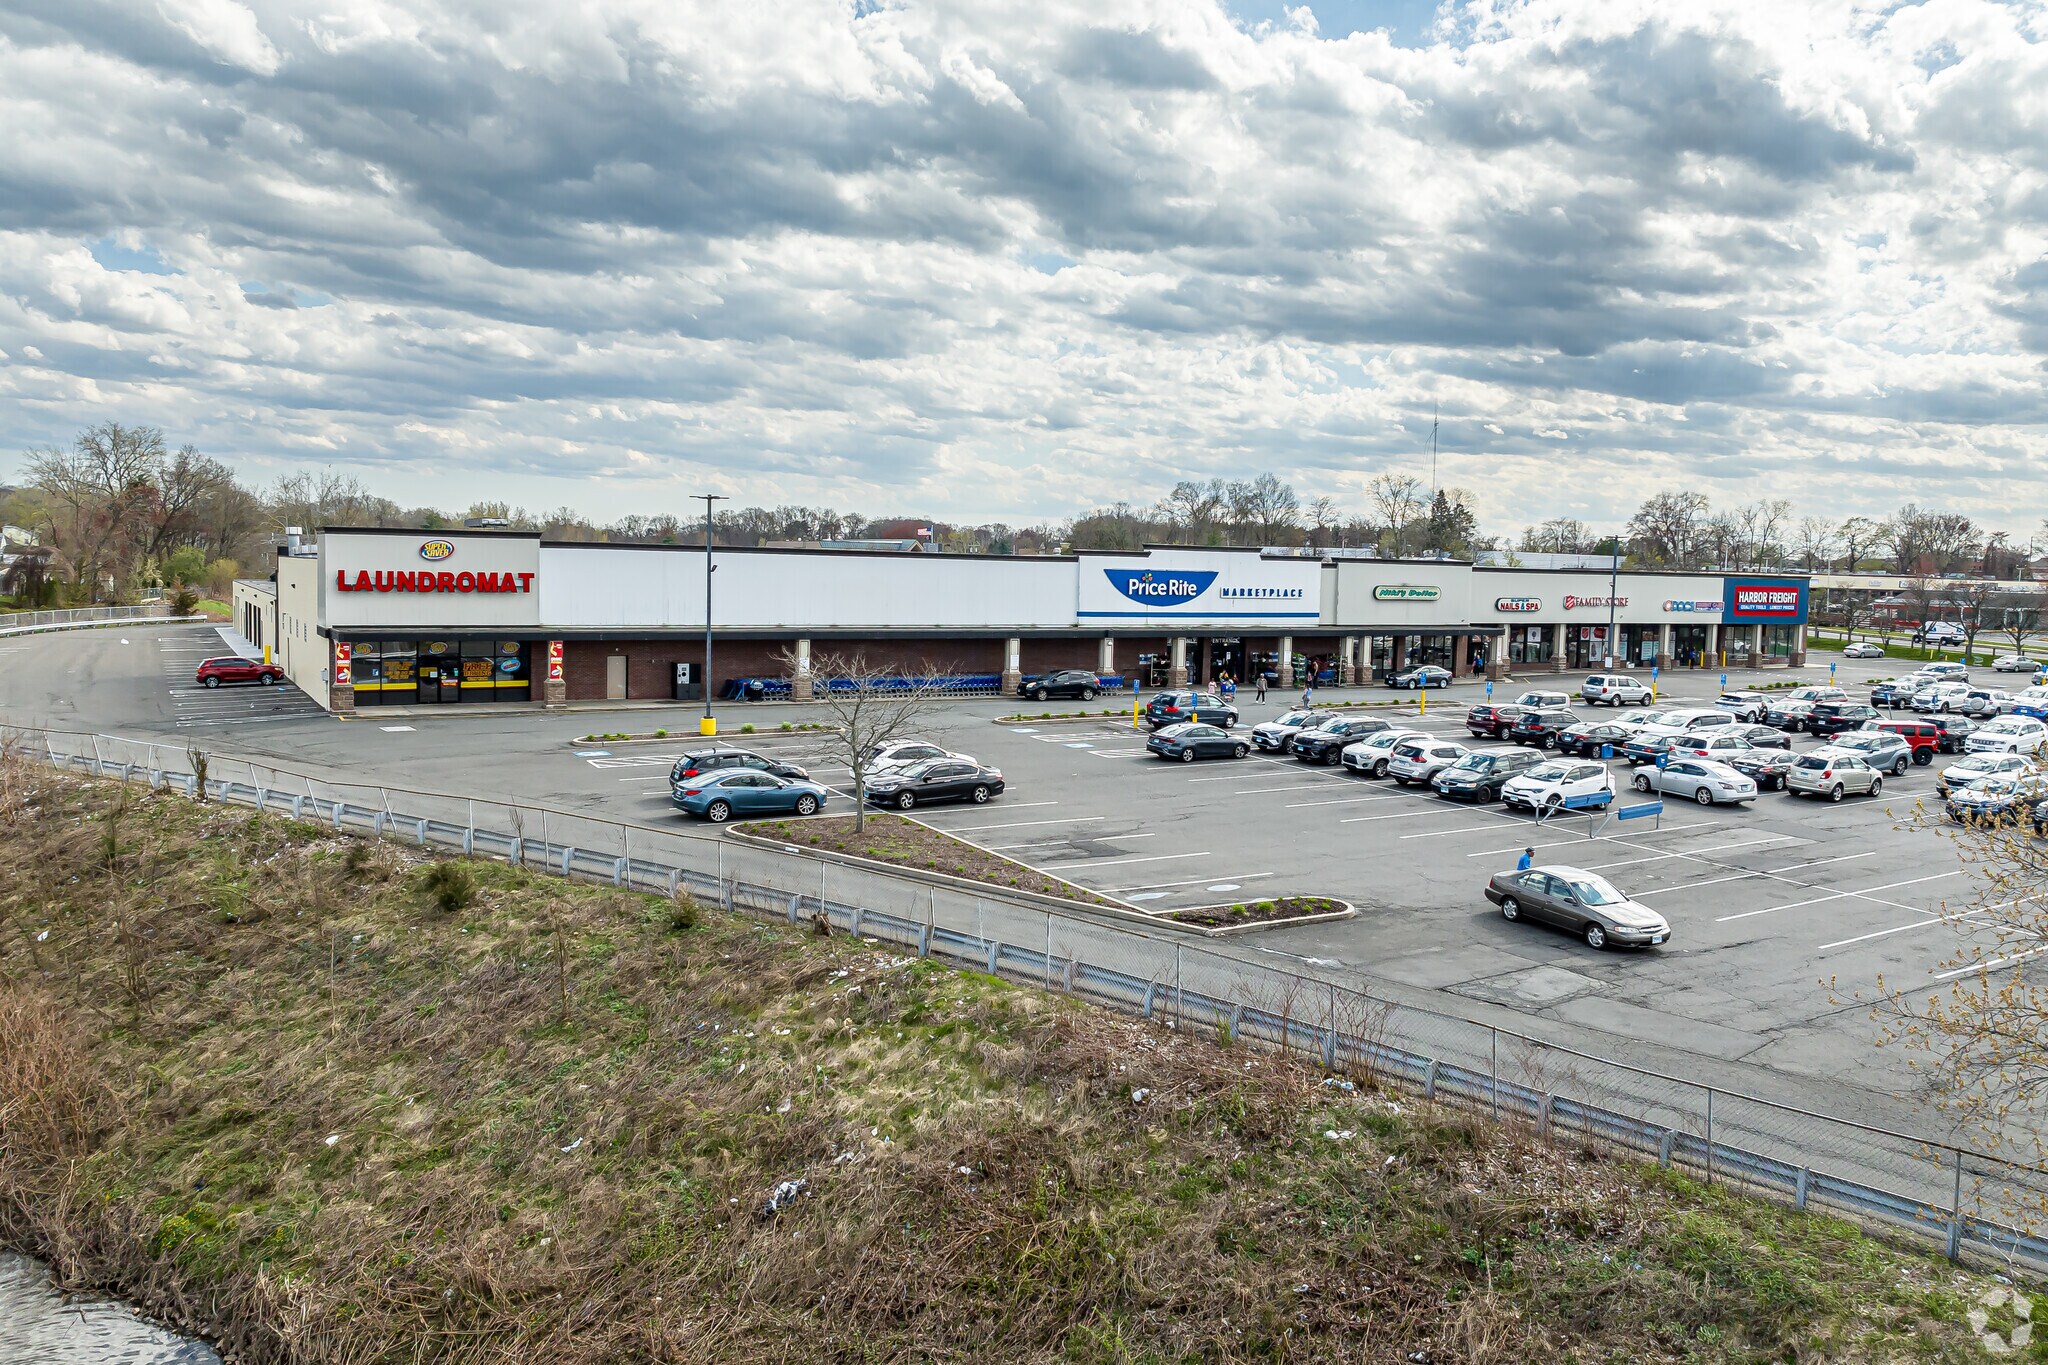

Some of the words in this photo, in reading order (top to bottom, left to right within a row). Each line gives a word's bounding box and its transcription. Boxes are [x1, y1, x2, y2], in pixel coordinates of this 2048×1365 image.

[425, 543, 447, 551] SUPER
[337, 569, 535, 593] LAUNDROMAT
[1128, 578, 1167, 596] Price
[1168, 579, 1197, 596] Rite
[1222, 588, 1303, 598] MARKETPLACE
[1738, 591, 1768, 603] HARBOR
[1769, 592, 1797, 603] FREIGHT
[1575, 597, 1603, 607] FAMILY
